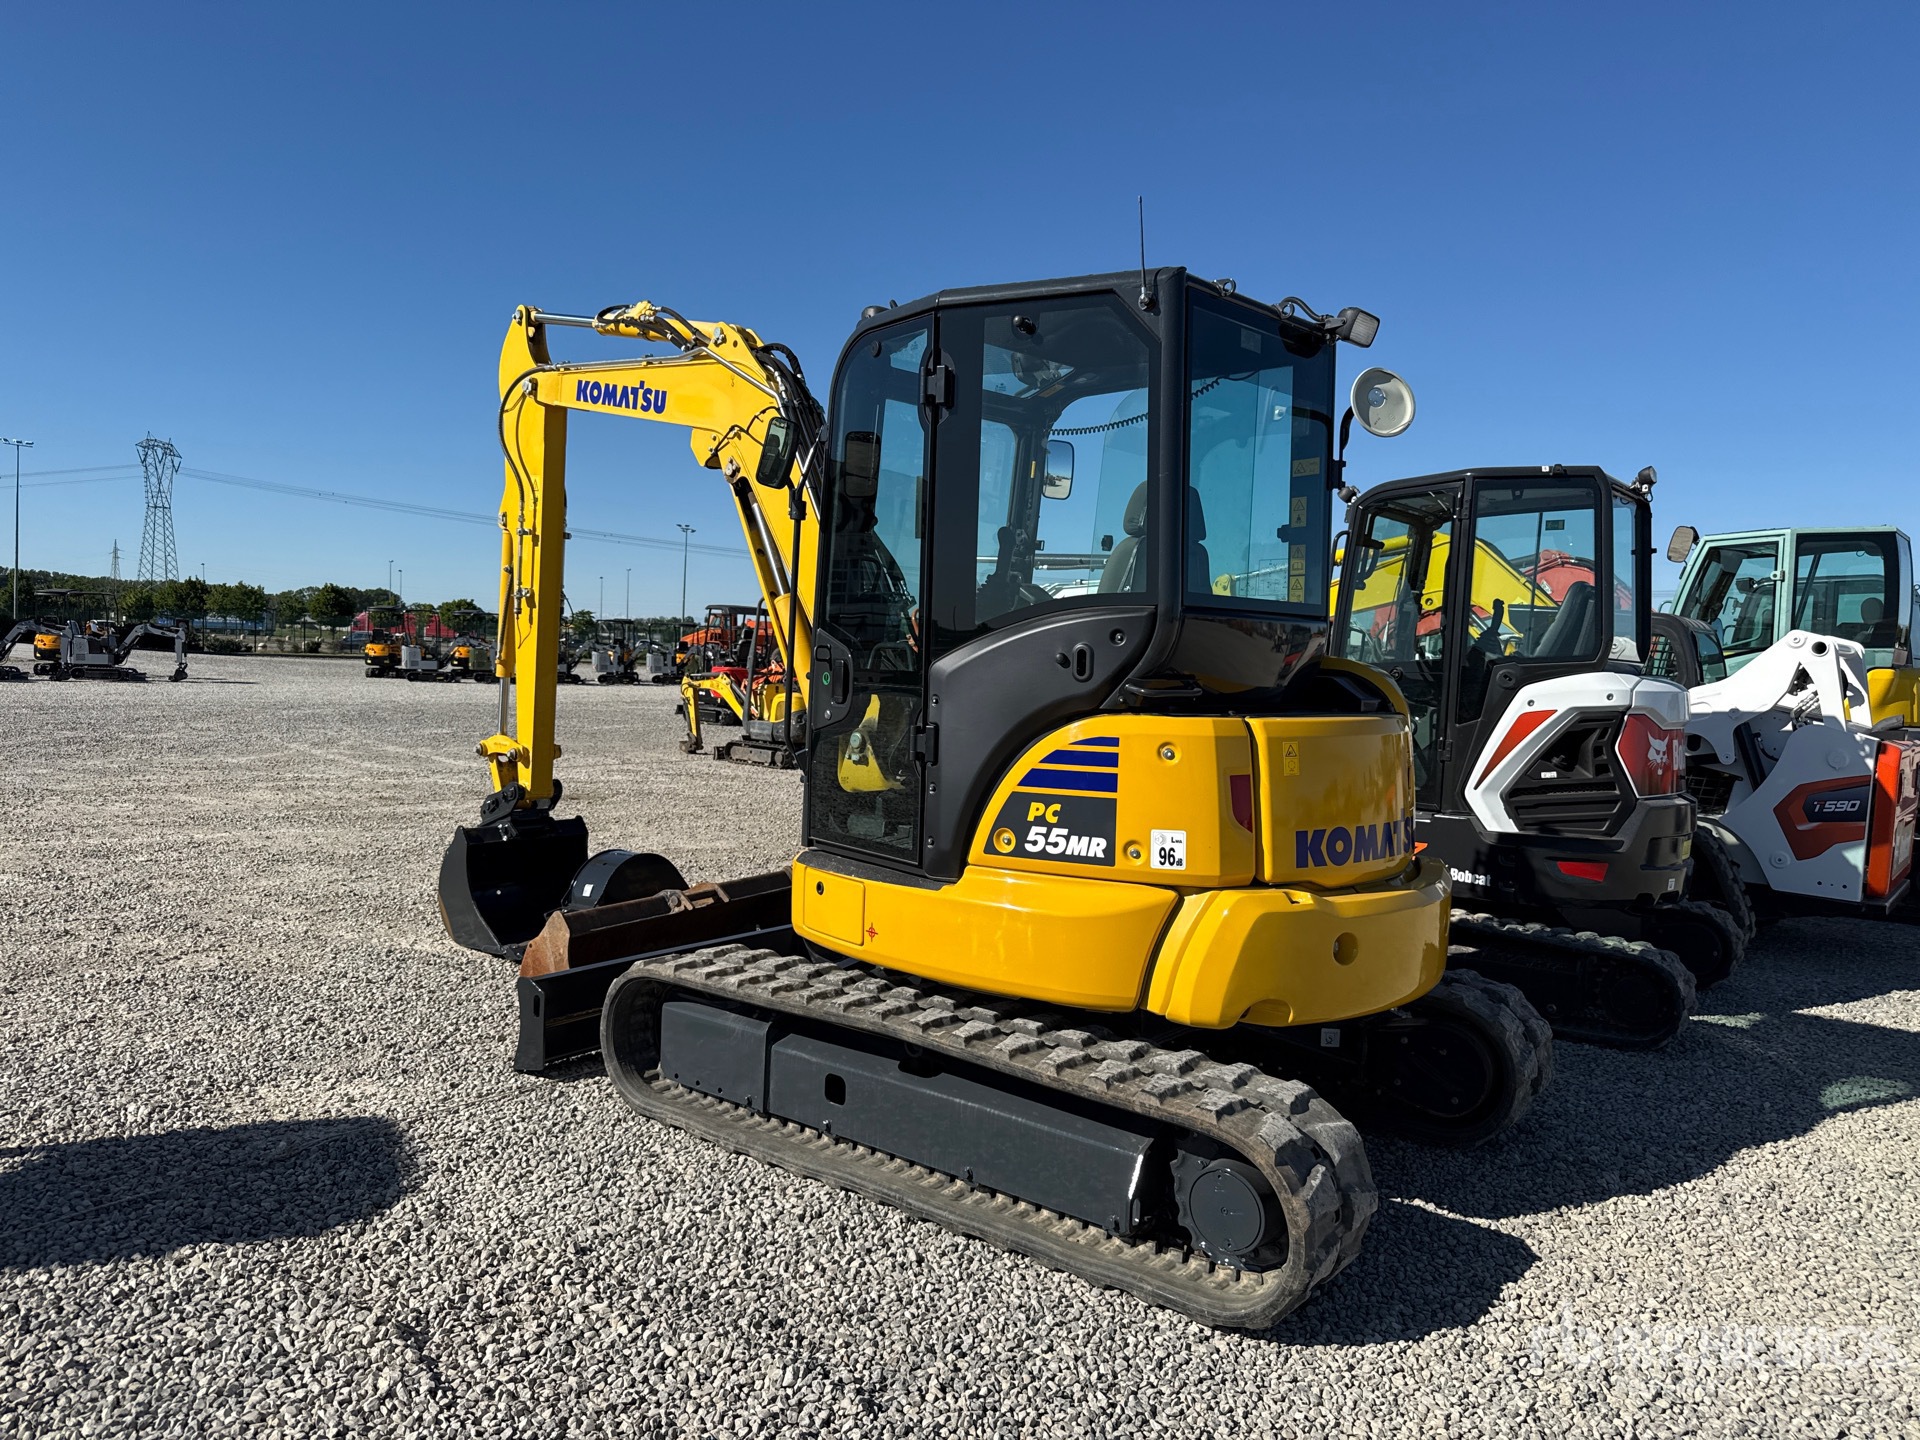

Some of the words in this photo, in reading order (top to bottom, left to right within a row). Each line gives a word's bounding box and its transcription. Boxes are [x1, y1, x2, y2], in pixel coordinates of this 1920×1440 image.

[576, 379, 668, 414] KOMATSU
[1027, 801, 1062, 823] PC
[1813, 800, 1861, 812] T590
[1024, 825, 1108, 858] 55MR
[1295, 808, 1415, 869] KOMATS
[1159, 846, 1176, 866] 96
[1450, 867, 1491, 887] Bobcat
